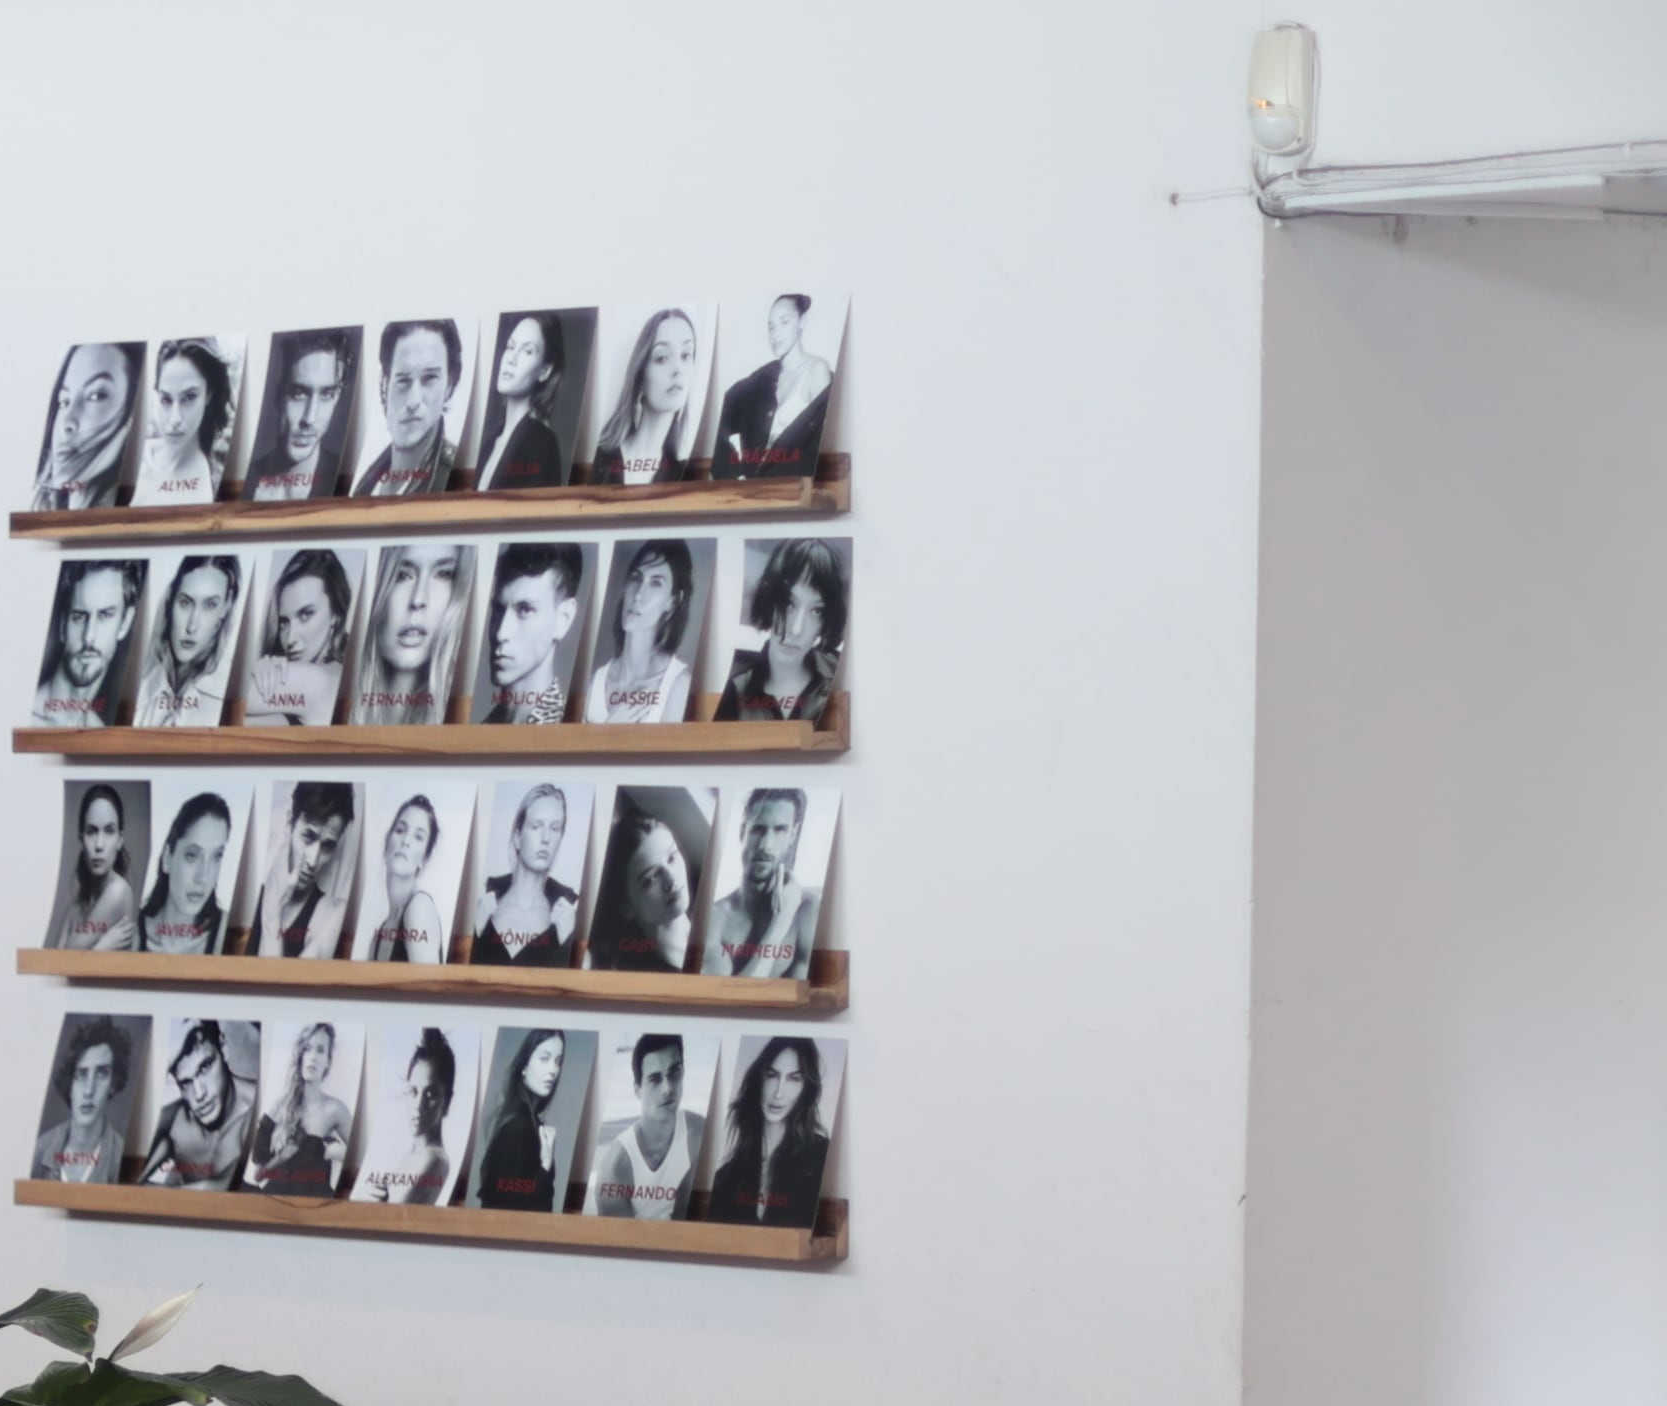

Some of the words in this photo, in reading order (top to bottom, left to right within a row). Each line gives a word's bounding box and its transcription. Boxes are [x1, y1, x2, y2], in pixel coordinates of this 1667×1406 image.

[158, 478, 200, 493] ALYNE
[268, 693, 307, 708] ANNA
[609, 690, 662, 706] CASSIE
[721, 943, 794, 960] MATHEUS
[496, 1177, 537, 1193] KASSI
[599, 1182, 676, 1202] FERNANDO
